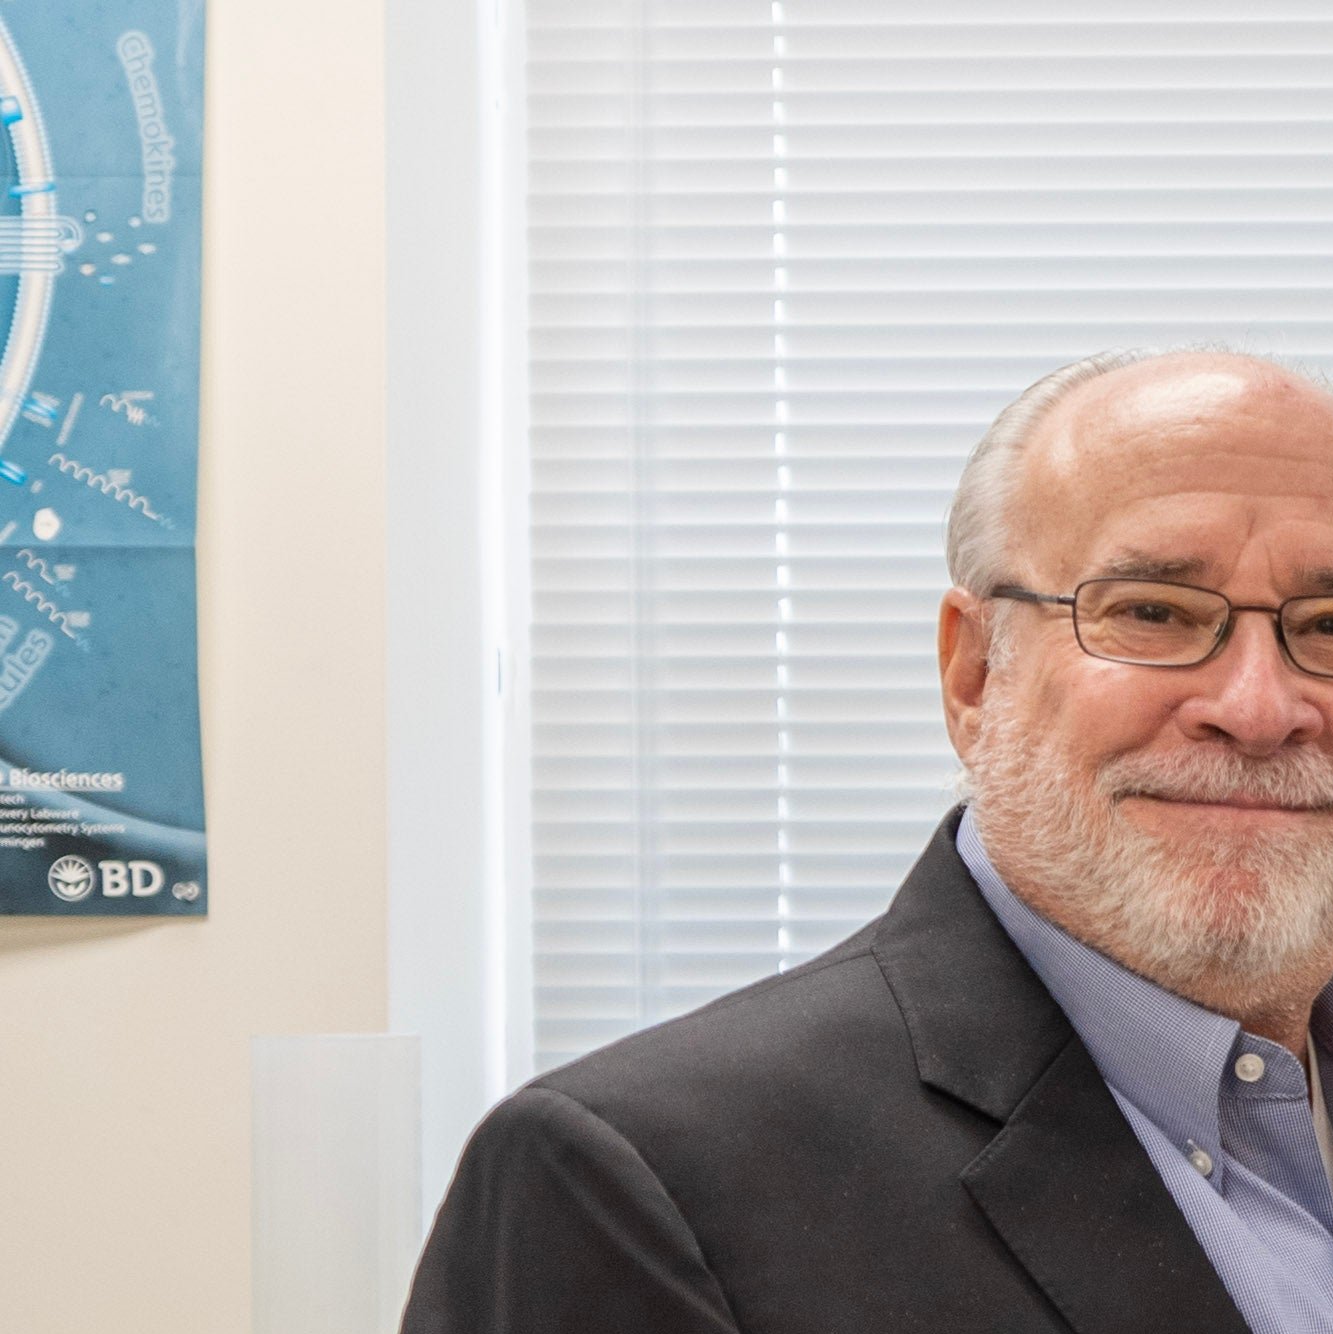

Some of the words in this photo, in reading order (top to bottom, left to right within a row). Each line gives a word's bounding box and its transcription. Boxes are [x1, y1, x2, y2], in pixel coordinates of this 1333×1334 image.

[120, 35, 172, 221] Chemokines
[9, 767, 124, 788] Biosciences
[0, 793, 26, 804] tech
[0, 808, 28, 820] overy
[30, 808, 80, 819] Labware
[0, 823, 79, 836] unocytometry
[80, 822, 126, 836] Systems
[0, 837, 46, 850] mingen
[97, 859, 165, 897] BD
